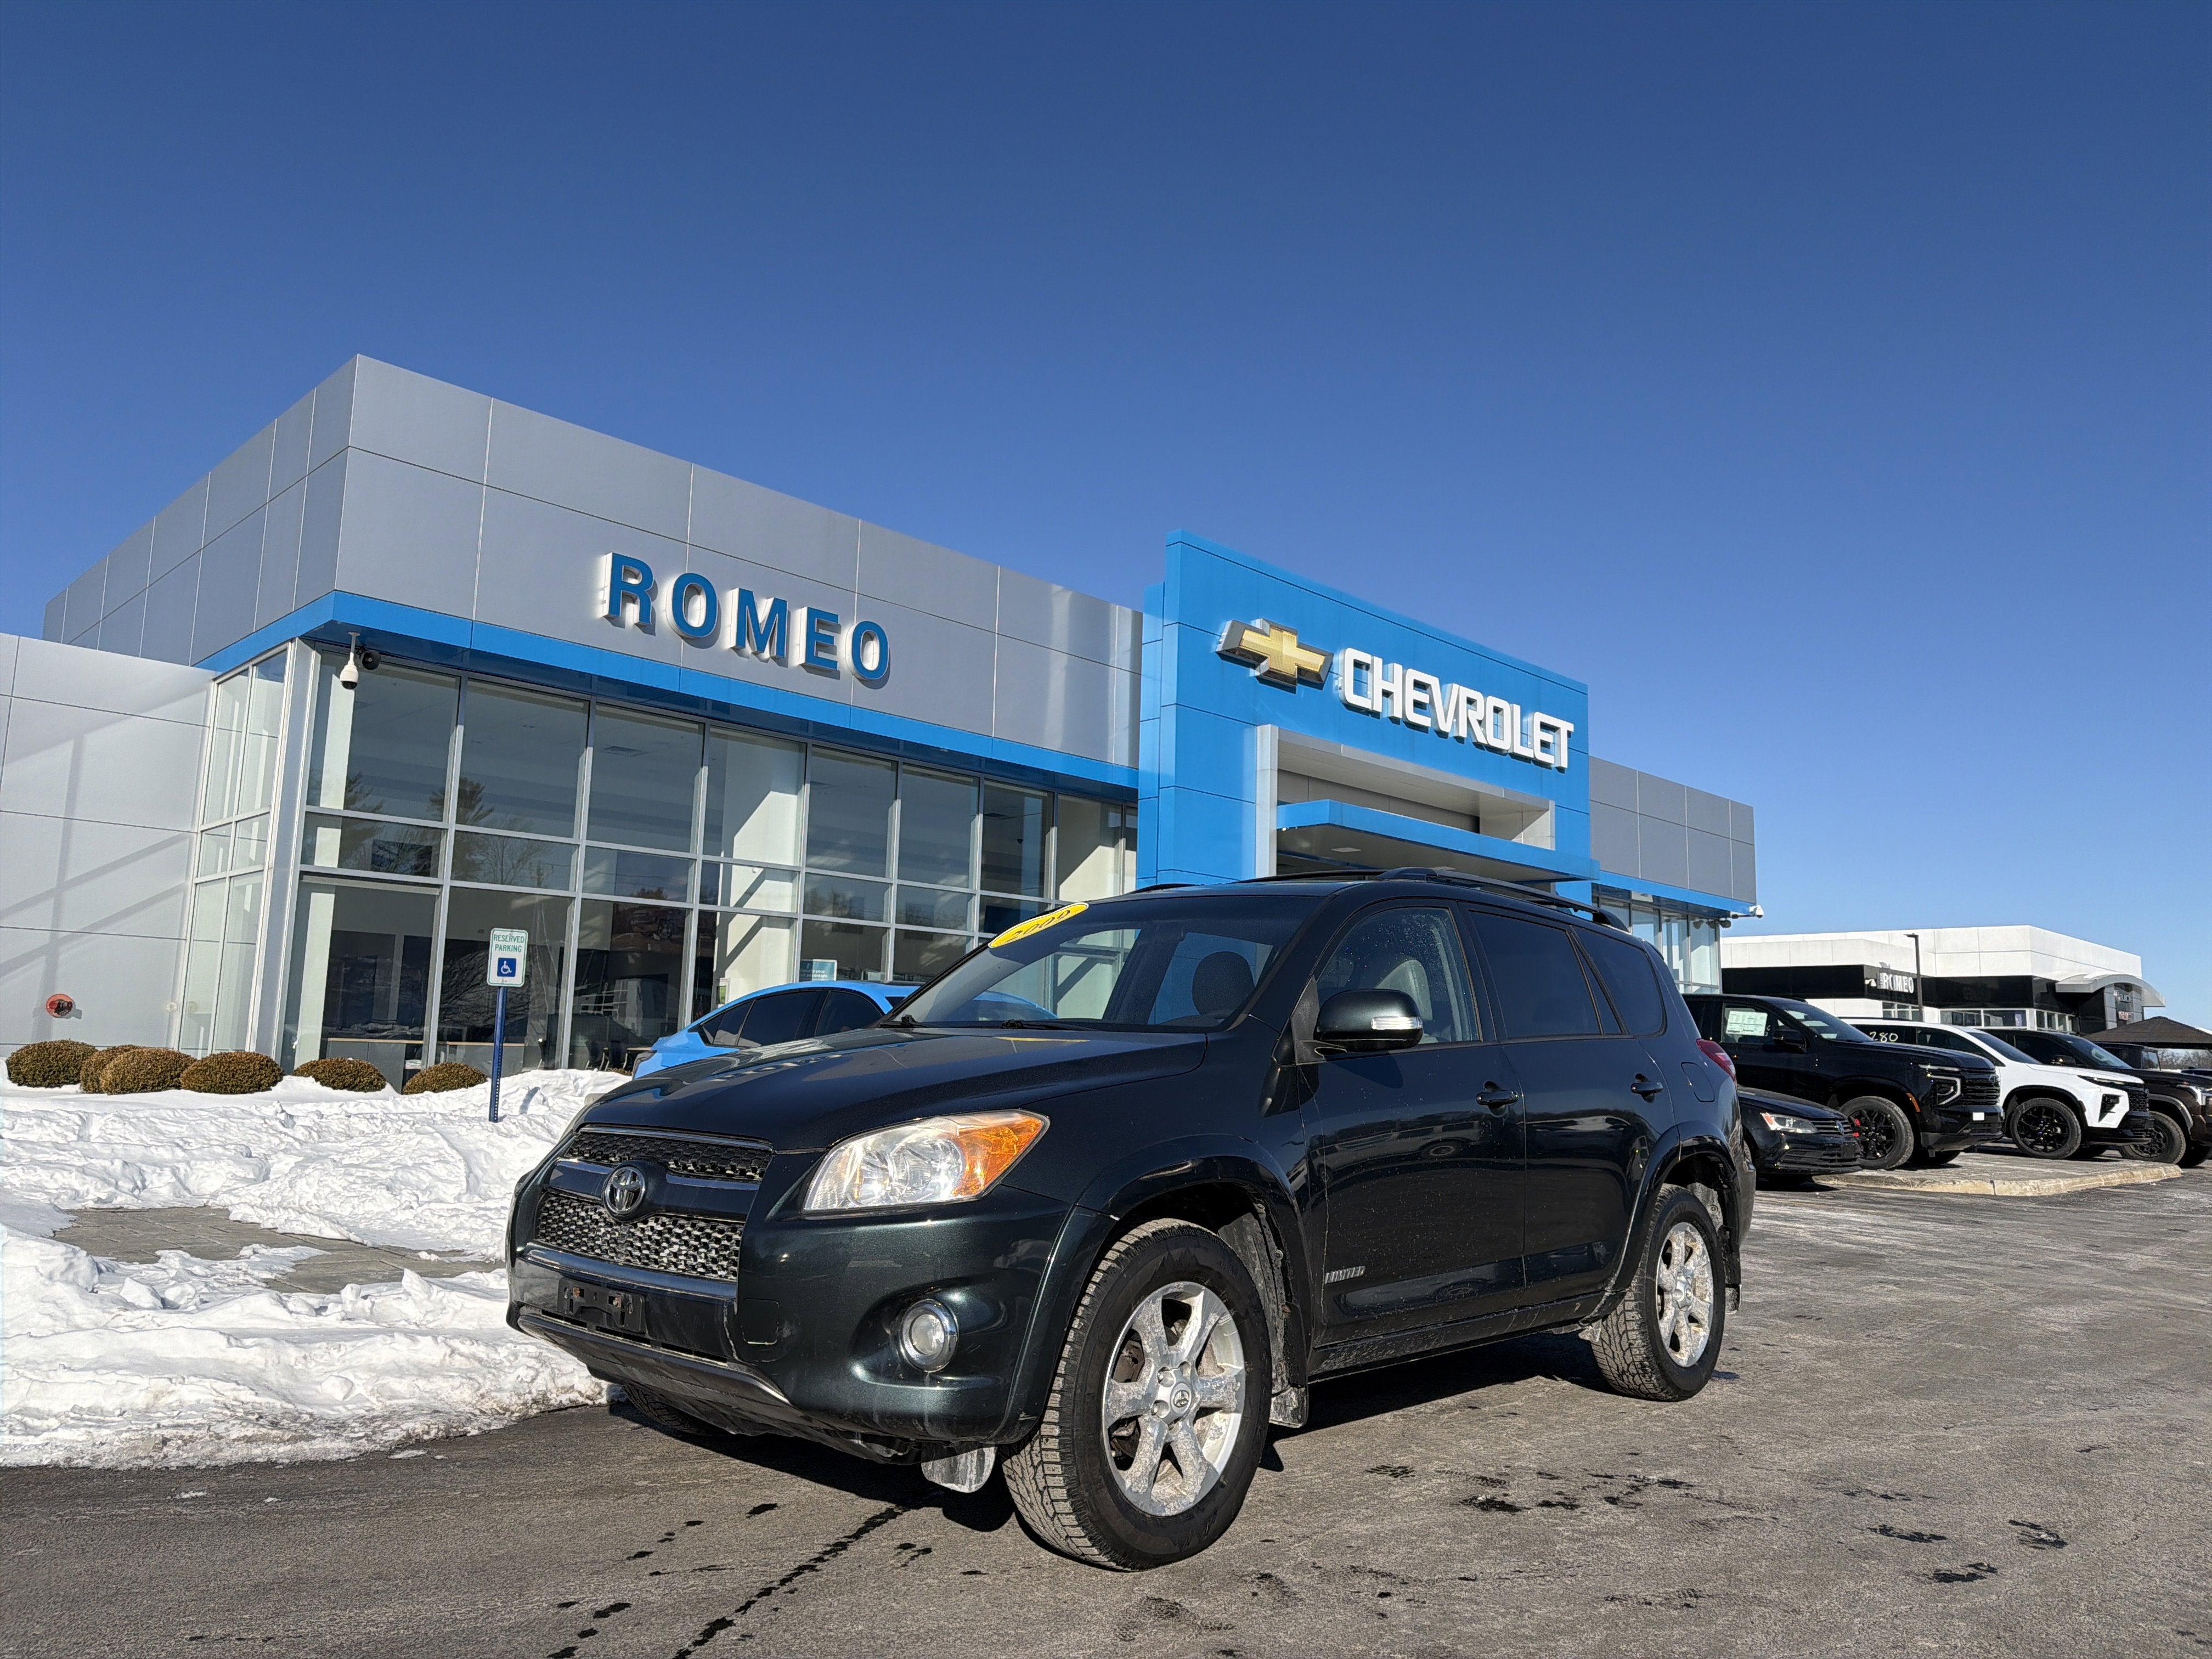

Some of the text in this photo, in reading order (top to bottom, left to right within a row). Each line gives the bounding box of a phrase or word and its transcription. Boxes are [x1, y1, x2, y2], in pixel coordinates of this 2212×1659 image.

[605, 552, 889, 680] ROMEO
[1342, 647, 1573, 769] CHEVROLET
[493, 934, 524, 943] RESERVED
[495, 944, 522, 953] PARKING
[1881, 973, 1914, 994] ROMEO
